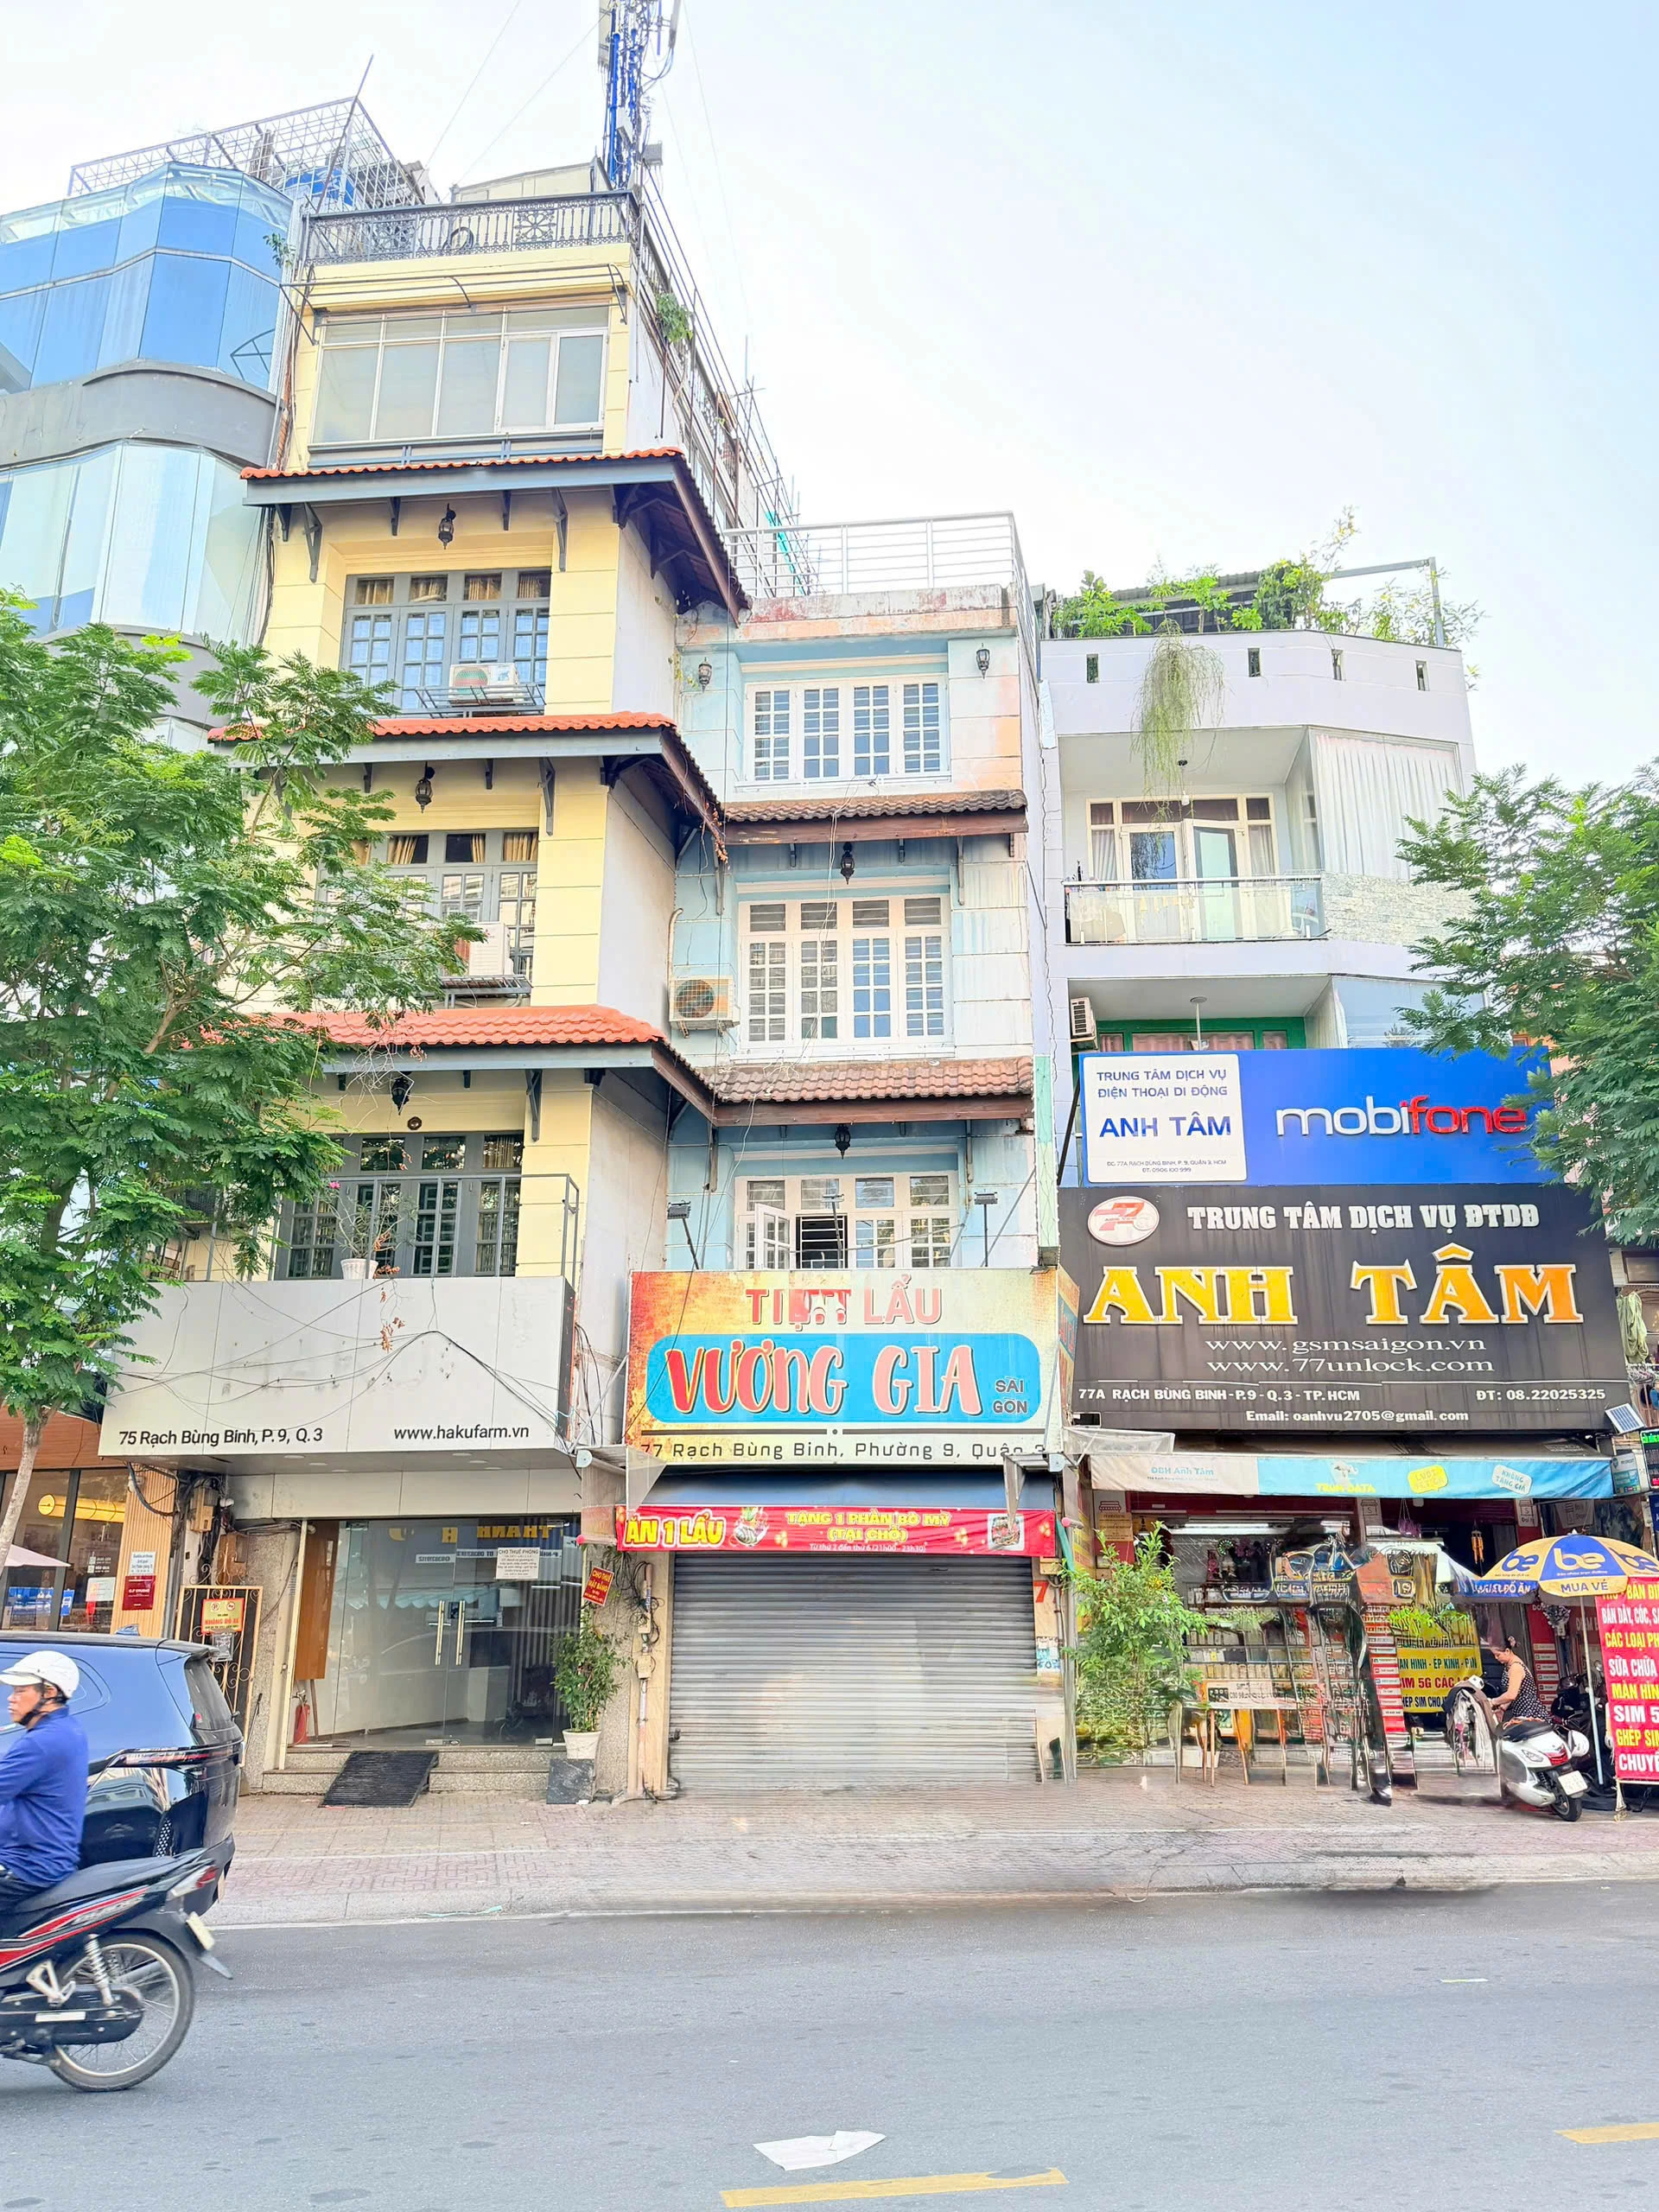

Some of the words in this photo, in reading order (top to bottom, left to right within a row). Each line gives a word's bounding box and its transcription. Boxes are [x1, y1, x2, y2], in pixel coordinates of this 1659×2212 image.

[1096, 1071, 1140, 1081] TRUNG
[1144, 1069, 1171, 1080] TÂM
[1176, 1070, 1205, 1081] DỊCH
[1209, 1069, 1227, 1080] VỤ
[1098, 1086, 1128, 1099] ĐIỆN
[1132, 1087, 1169, 1098] THOẠI
[1174, 1086, 1186, 1096] DI
[1191, 1085, 1228, 1097] ĐỘNG
[1099, 1116, 1159, 1137] ANH
[1169, 1111, 1231, 1136] TÂM
[1276, 1095, 1528, 1136] mobifone
[1187, 1205, 1276, 1230] TRUNG
[1284, 1200, 1343, 1230] TÂM
[1349, 1205, 1414, 1234] DỊCH
[1419, 1205, 1456, 1234] VỤ
[1464, 1204, 1541, 1228] ĐTDĐ
[1083, 1265, 1299, 1325] ANH
[1350, 1242, 1585, 1325] TÂM
[863, 1274, 942, 1325] LẨU
[873, 1344, 983, 1416] GIA
[1078, 1389, 1105, 1400] 77A
[1112, 1389, 1150, 1402] RẠCH
[1154, 1387, 1192, 1401] BÙNG
[1475, 1389, 1502, 1401] ĐT:
[1506, 1389, 1606, 1401] 08.22025325
[1246, 1410, 1289, 1422] Email:
[118, 1431, 137, 1445] 75
[140, 1430, 176, 1448] Rạch
[181, 1429, 219, 1447] Bùng
[394, 1424, 530, 1440] www.hakufarm.vn
[641, 1443, 663, 1458] 77
[673, 1442, 722, 1459] Rạch
[734, 1441, 783, 1460] Bùng
[794, 1441, 844, 1458] Binh,
[855, 1441, 932, 1460] Phường
[944, 1443, 960, 1459] 9,
[1174, 1466, 1192, 1475] Anh
[623, 1513, 658, 1548] ĂN
[662, 1517, 677, 1548] 1
[678, 1509, 727, 1548] LẨU
[836, 1513, 844, 1525] 1
[1502, 1548, 1540, 1572] be
[1554, 1548, 1606, 1571] be
[1560, 1582, 1589, 1593] MUA
[1592, 1579, 1609, 1592] VÉ
[1605, 1630, 1624, 1648] CÁC
[1624, 1631, 1646, 1652] LOẠI
[1418, 1677, 1432, 1689] 5G
[1434, 1675, 1455, 1689] CÁC
[1414, 1696, 1427, 1708] SIM
[1427, 1696, 1441, 1708] CHO
[1613, 1705, 1646, 1723] SIM
[1616, 1726, 1642, 1746] GHÉP
